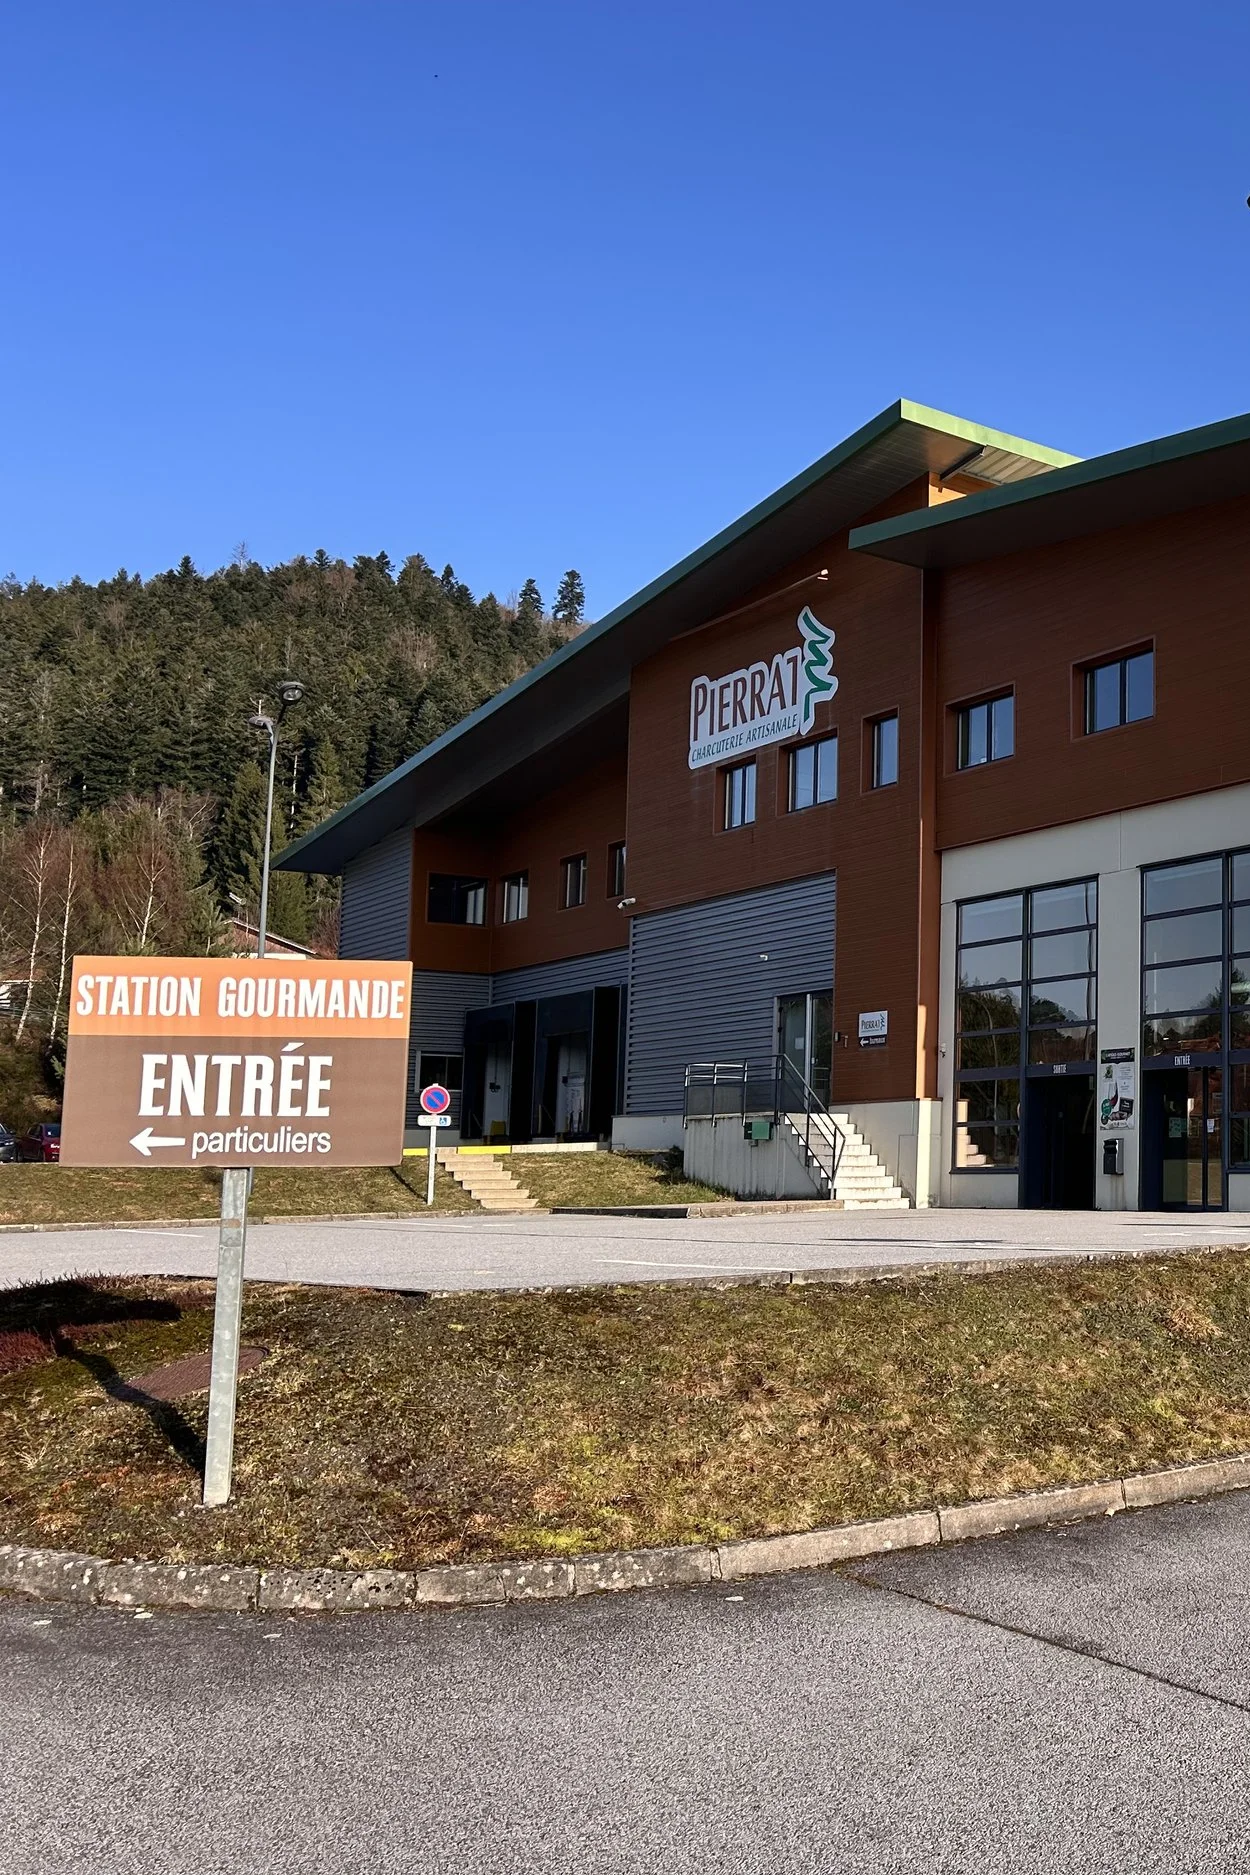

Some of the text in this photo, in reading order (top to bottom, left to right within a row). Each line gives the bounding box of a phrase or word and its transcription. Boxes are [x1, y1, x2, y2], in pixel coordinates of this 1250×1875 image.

[692, 655, 798, 742] PIERRAT
[691, 713, 798, 762] CHARCUTERIE ARTISANALE
[76, 974, 405, 1019] STATION GOURMANDE
[137, 1042, 333, 1117] ENTRÉE
[1174, 1053, 1190, 1066] ENTRÉE
[191, 1125, 331, 1159] particuliers
